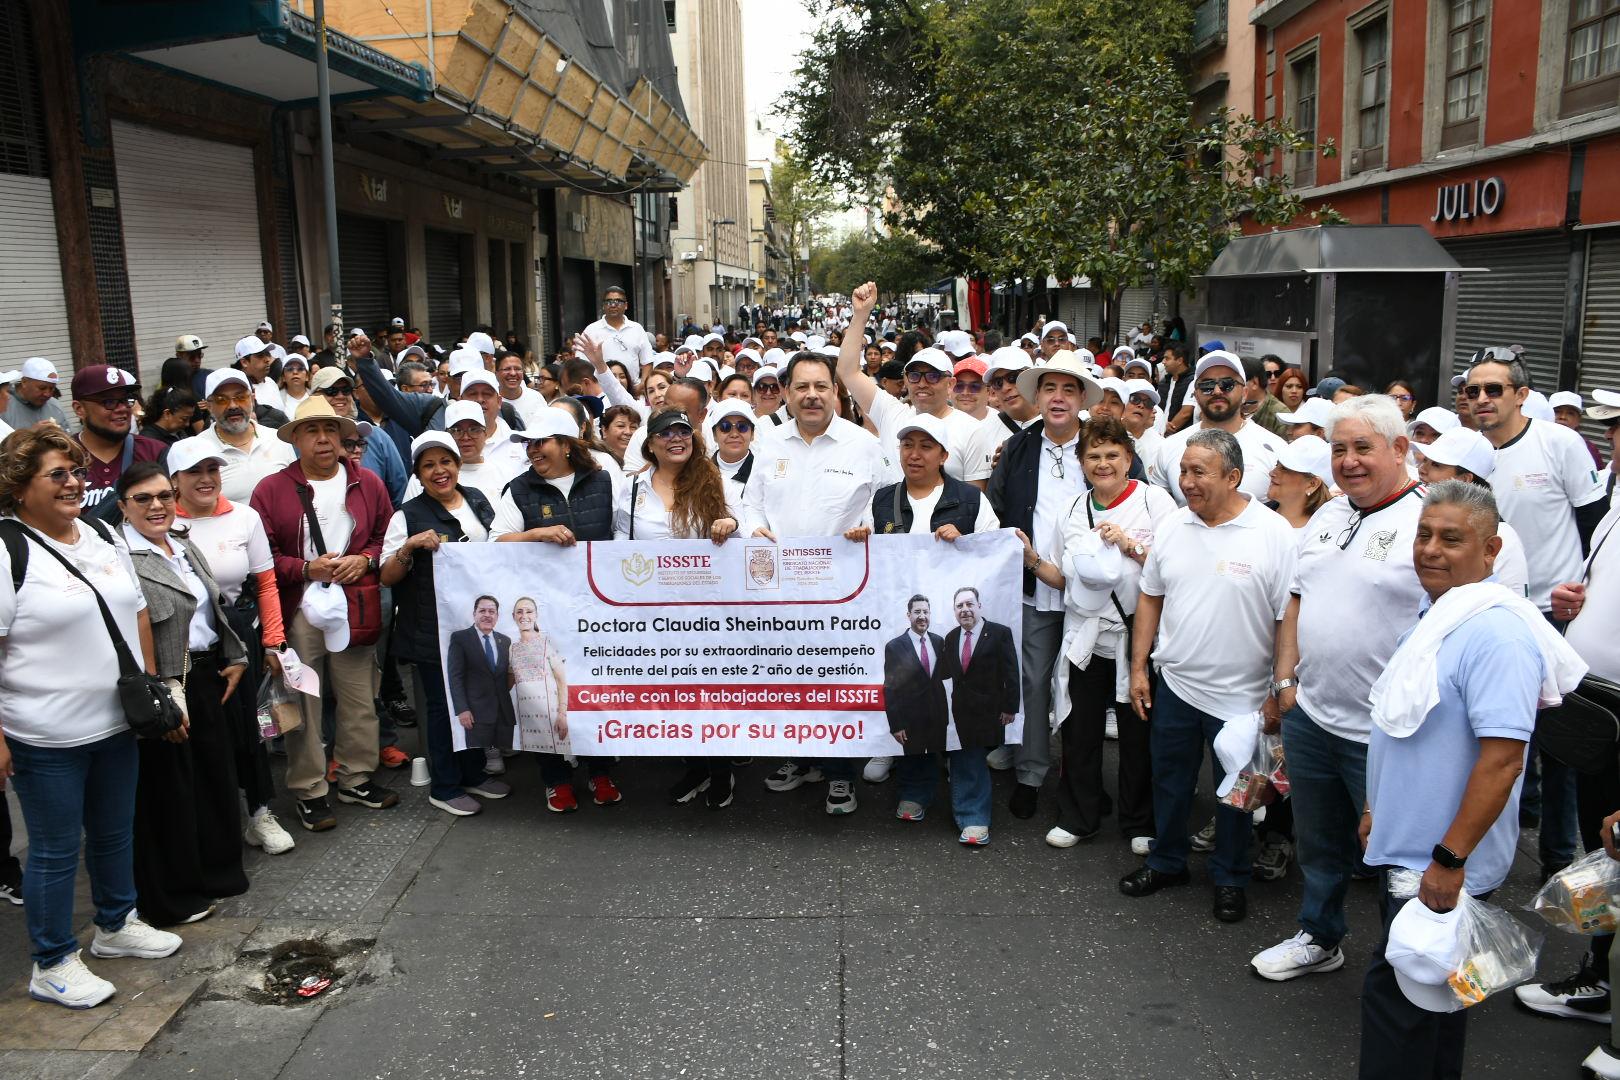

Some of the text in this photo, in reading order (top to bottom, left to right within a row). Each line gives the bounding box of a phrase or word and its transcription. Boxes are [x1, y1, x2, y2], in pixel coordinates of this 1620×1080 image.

[371, 177, 388, 202] taf
[450, 197, 463, 219] taf
[1430, 177, 1504, 222] JULIO
[782, 548, 833, 557] SNTISSSTE
[656, 555, 711, 568] ISSSTE
[578, 615, 882, 633] Doctora Claudia Sheinbaum Pardo
[583, 643, 876, 659] Felicidades por su extraordinario desempeño
[591, 665, 603, 676] al
[606, 664, 644, 676] frente
[647, 664, 668, 676] del
[671, 663, 698, 679] país
[701, 666, 718, 676] en
[721, 664, 749, 676] este
[767, 663, 793, 676] año
[796, 664, 814, 676] de
[817, 662, 868, 679] gestión.
[577, 689, 879, 706] Cuente con los trabajadores del ISSSTE
[598, 719, 864, 745] ¡Gracias por su apoyo!
